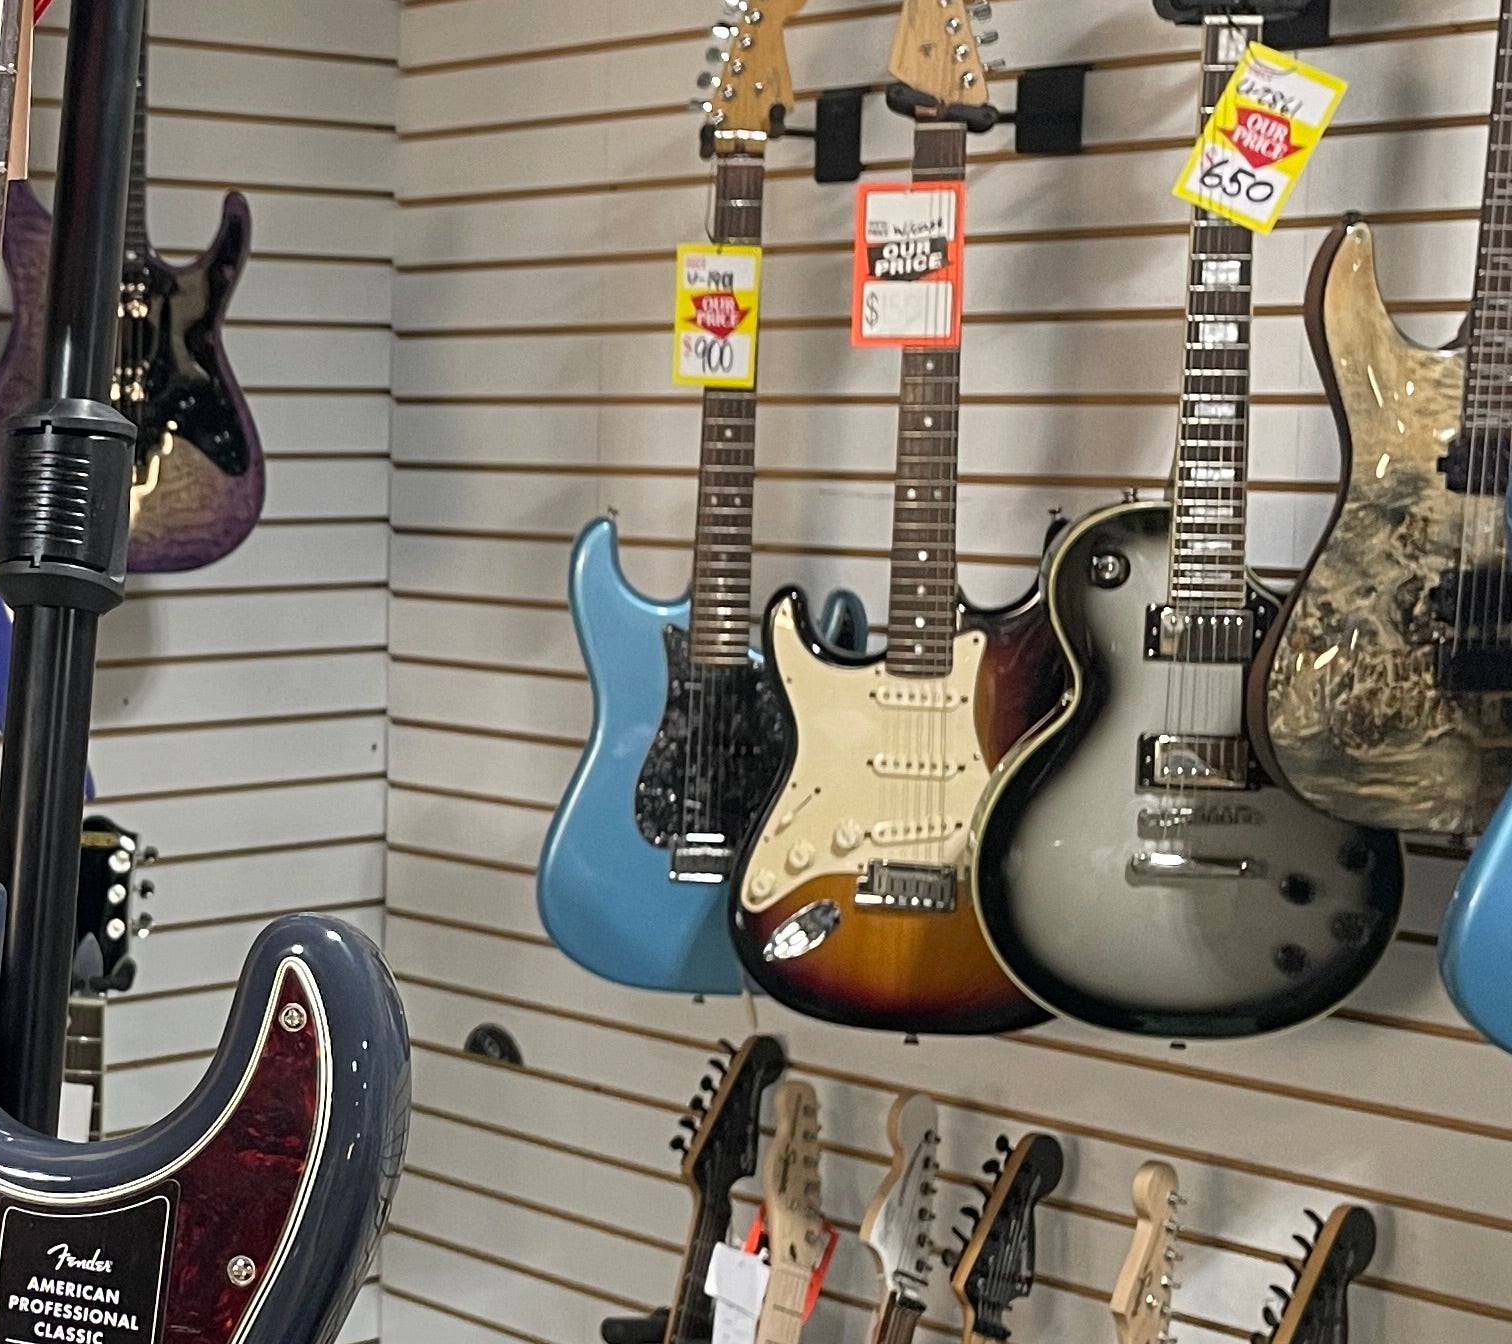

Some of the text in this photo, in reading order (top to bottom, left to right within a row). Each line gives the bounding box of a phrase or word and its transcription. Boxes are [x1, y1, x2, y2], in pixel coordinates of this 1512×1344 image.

[1246, 112, 1290, 142] OUR
[1232, 125, 1289, 161] PRICE
[882, 240, 932, 259] OUR
[874, 251, 943, 278] PRICE
[701, 295, 737, 312] OUR
[695, 308, 739, 329] PRICE
[46, 1242, 114, 1274] Fender
[26, 1276, 121, 1305] AMERICAN
[8, 1294, 140, 1332] PROFESSIONAL
